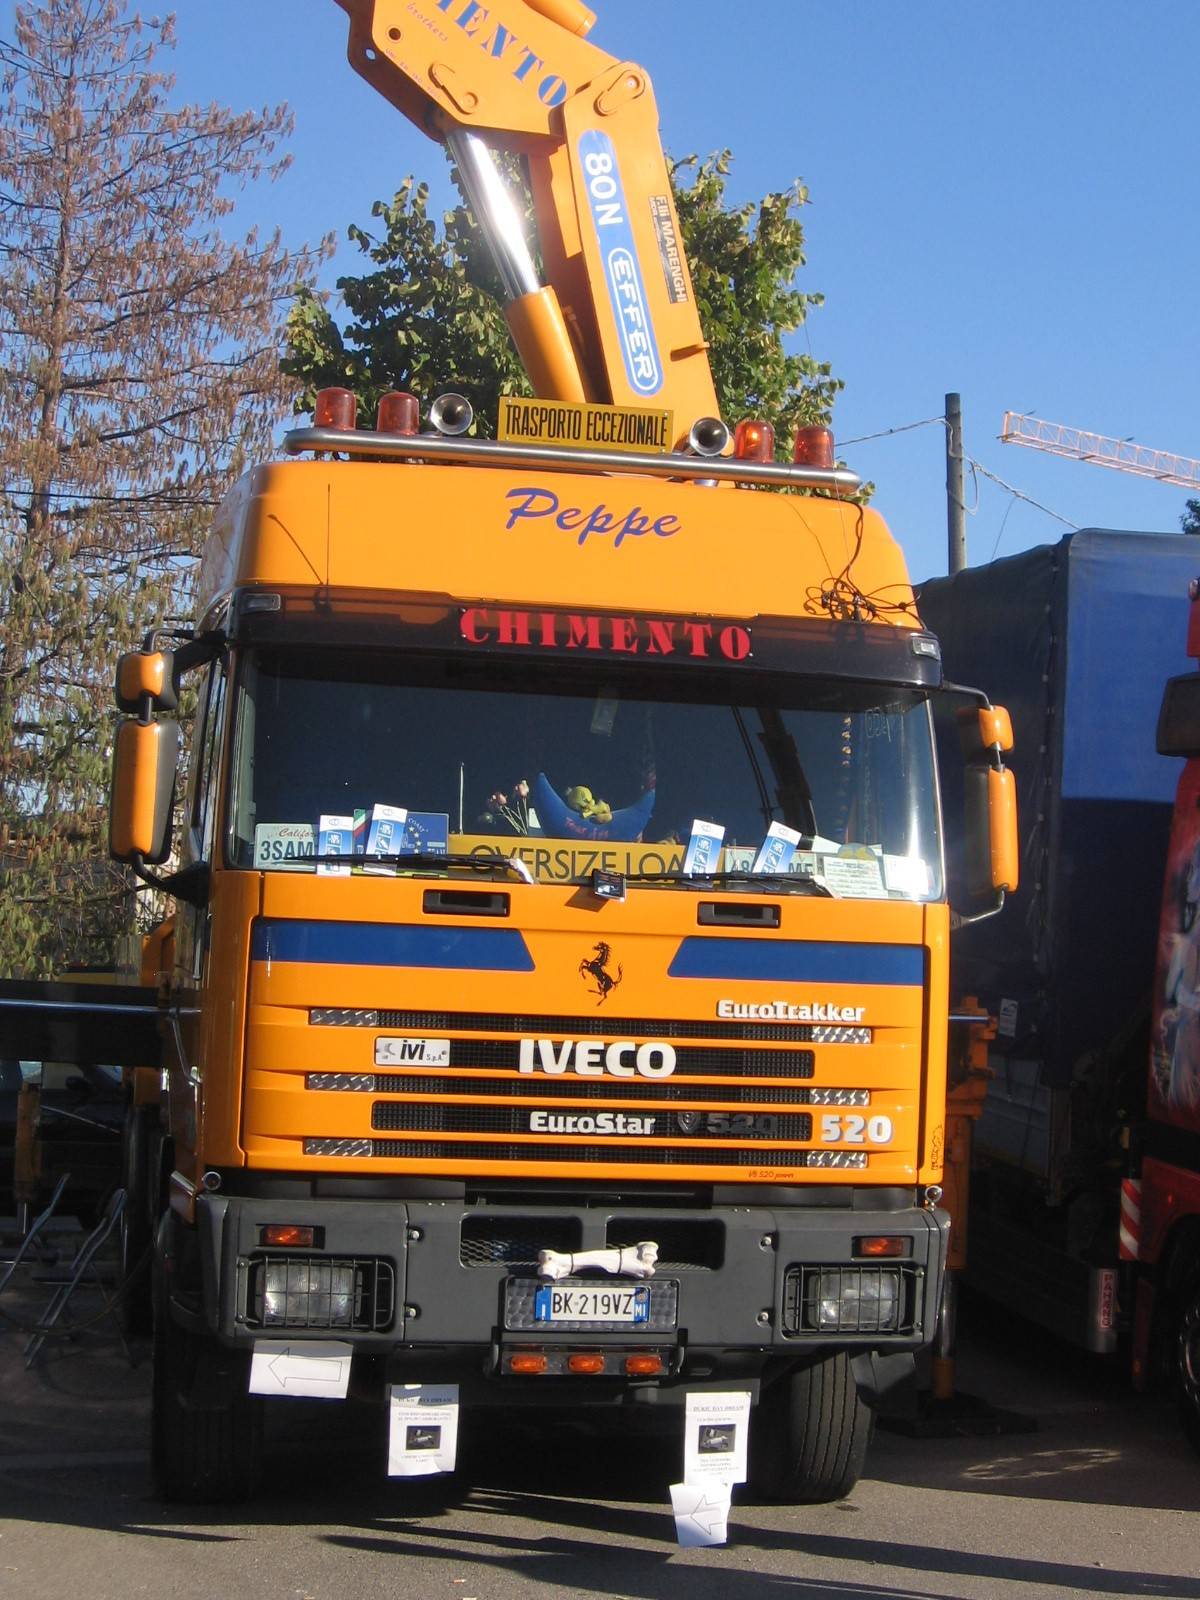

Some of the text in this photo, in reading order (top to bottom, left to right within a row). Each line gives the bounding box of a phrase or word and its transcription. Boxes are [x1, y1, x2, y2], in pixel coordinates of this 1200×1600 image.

[661, 219, 687, 303] MARENGHI
[613, 256, 653, 378] EFFER
[505, 404, 668, 447] TRASPORTO ECCEZIONALE
[505, 487, 682, 548] Peppe
[459, 607, 752, 661] CHIMENTO
[260, 840, 314, 861] 3SAM
[625, 850, 684, 882] LOA
[717, 999, 866, 1022] EuroTrakker
[518, 1038, 677, 1078] IVECO
[529, 1110, 656, 1136] EuroStar
[706, 1113, 777, 1134] 520
[820, 1114, 893, 1143] 520
